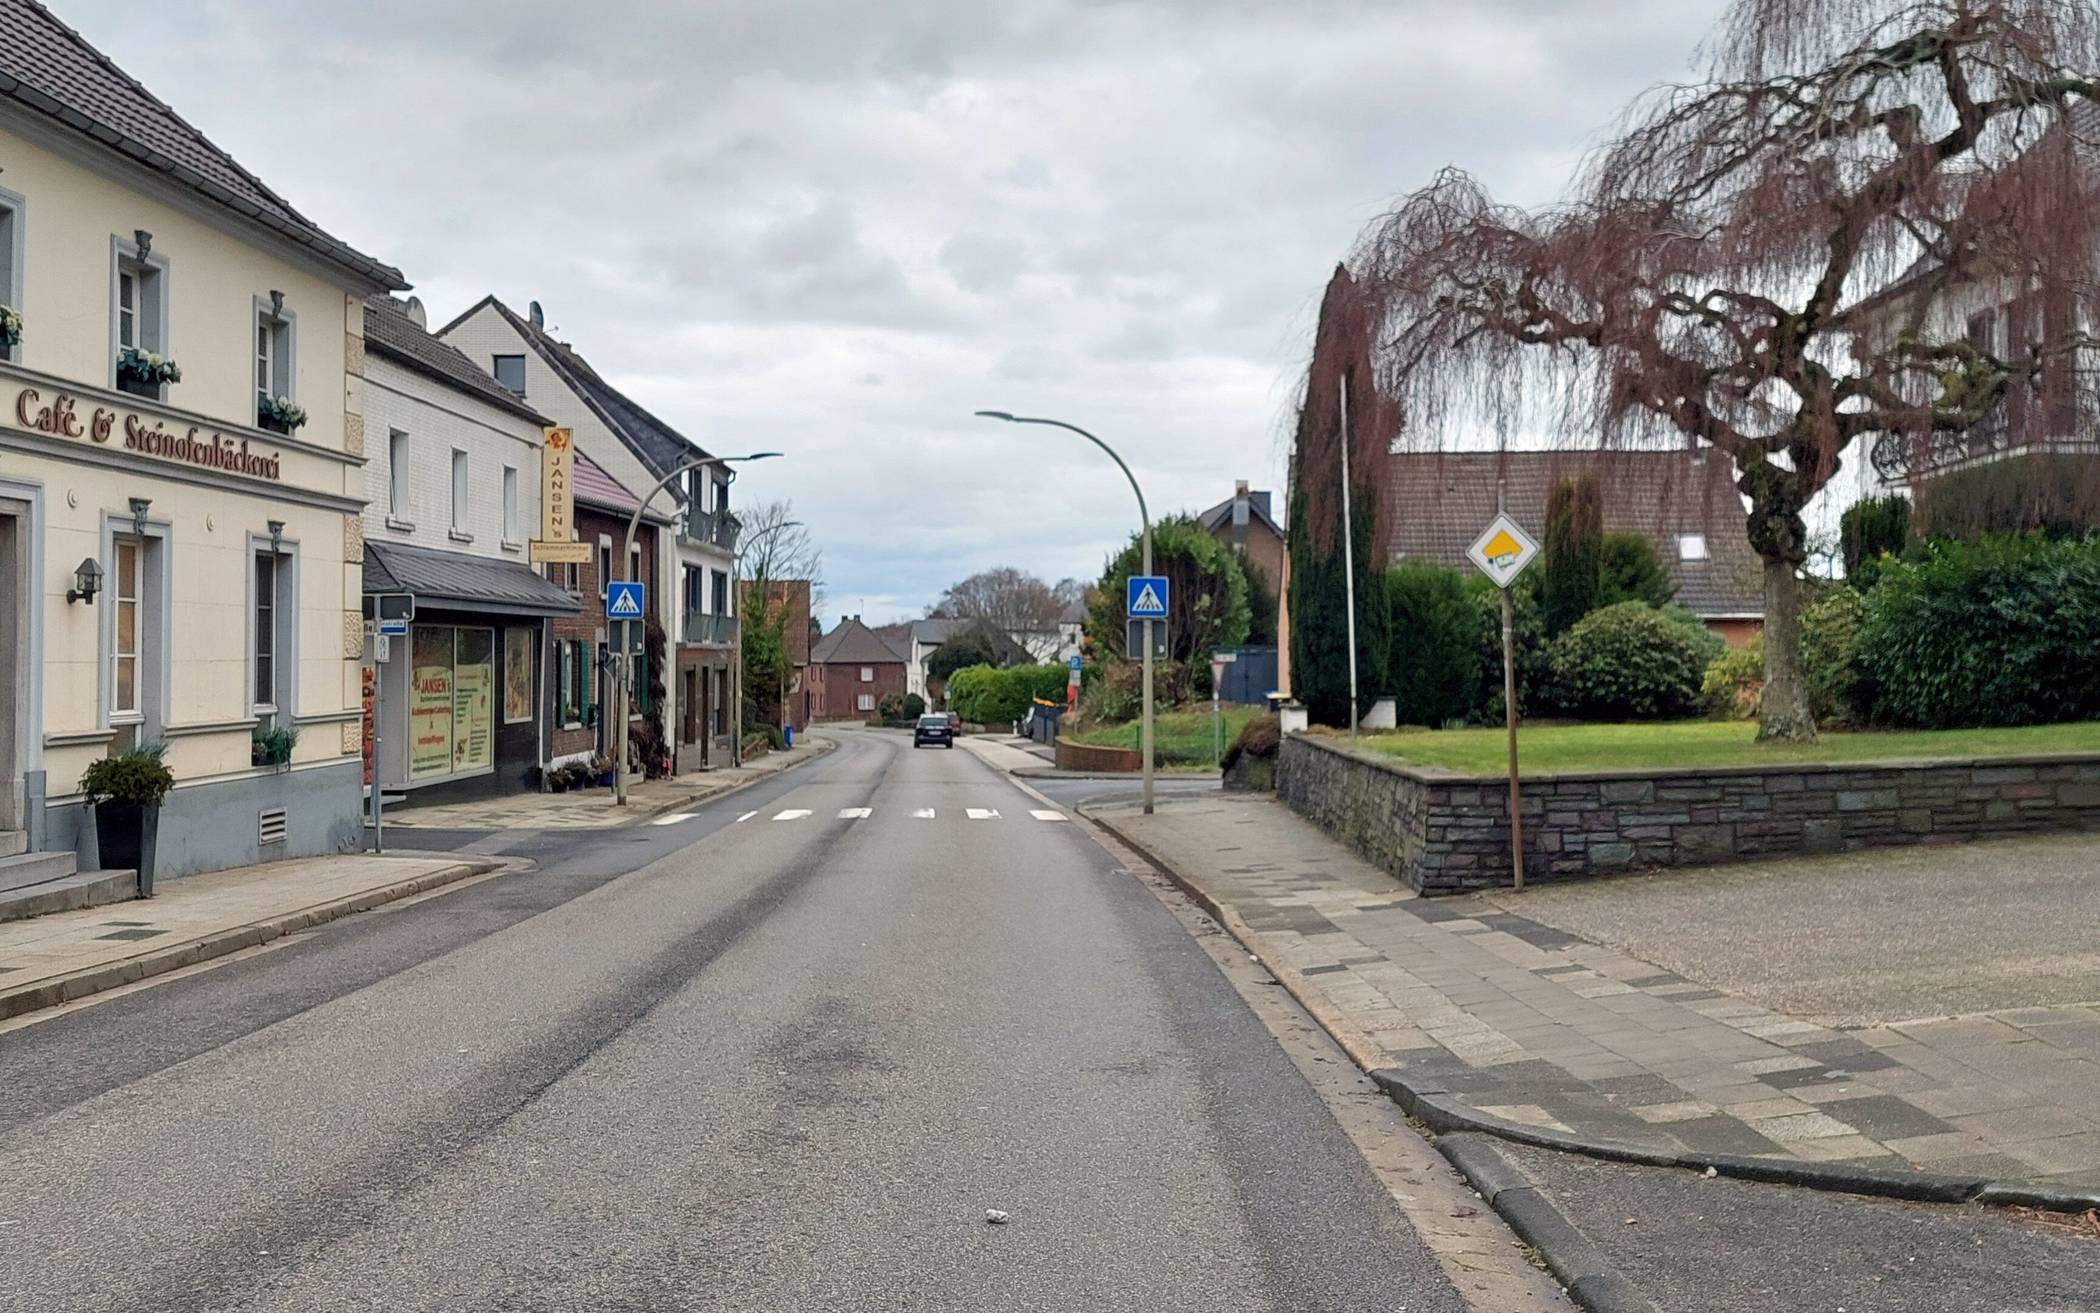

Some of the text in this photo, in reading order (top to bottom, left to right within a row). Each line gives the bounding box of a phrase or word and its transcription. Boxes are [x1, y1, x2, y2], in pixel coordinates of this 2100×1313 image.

[16, 388, 281, 480] Café & Steinofenbäckerei
